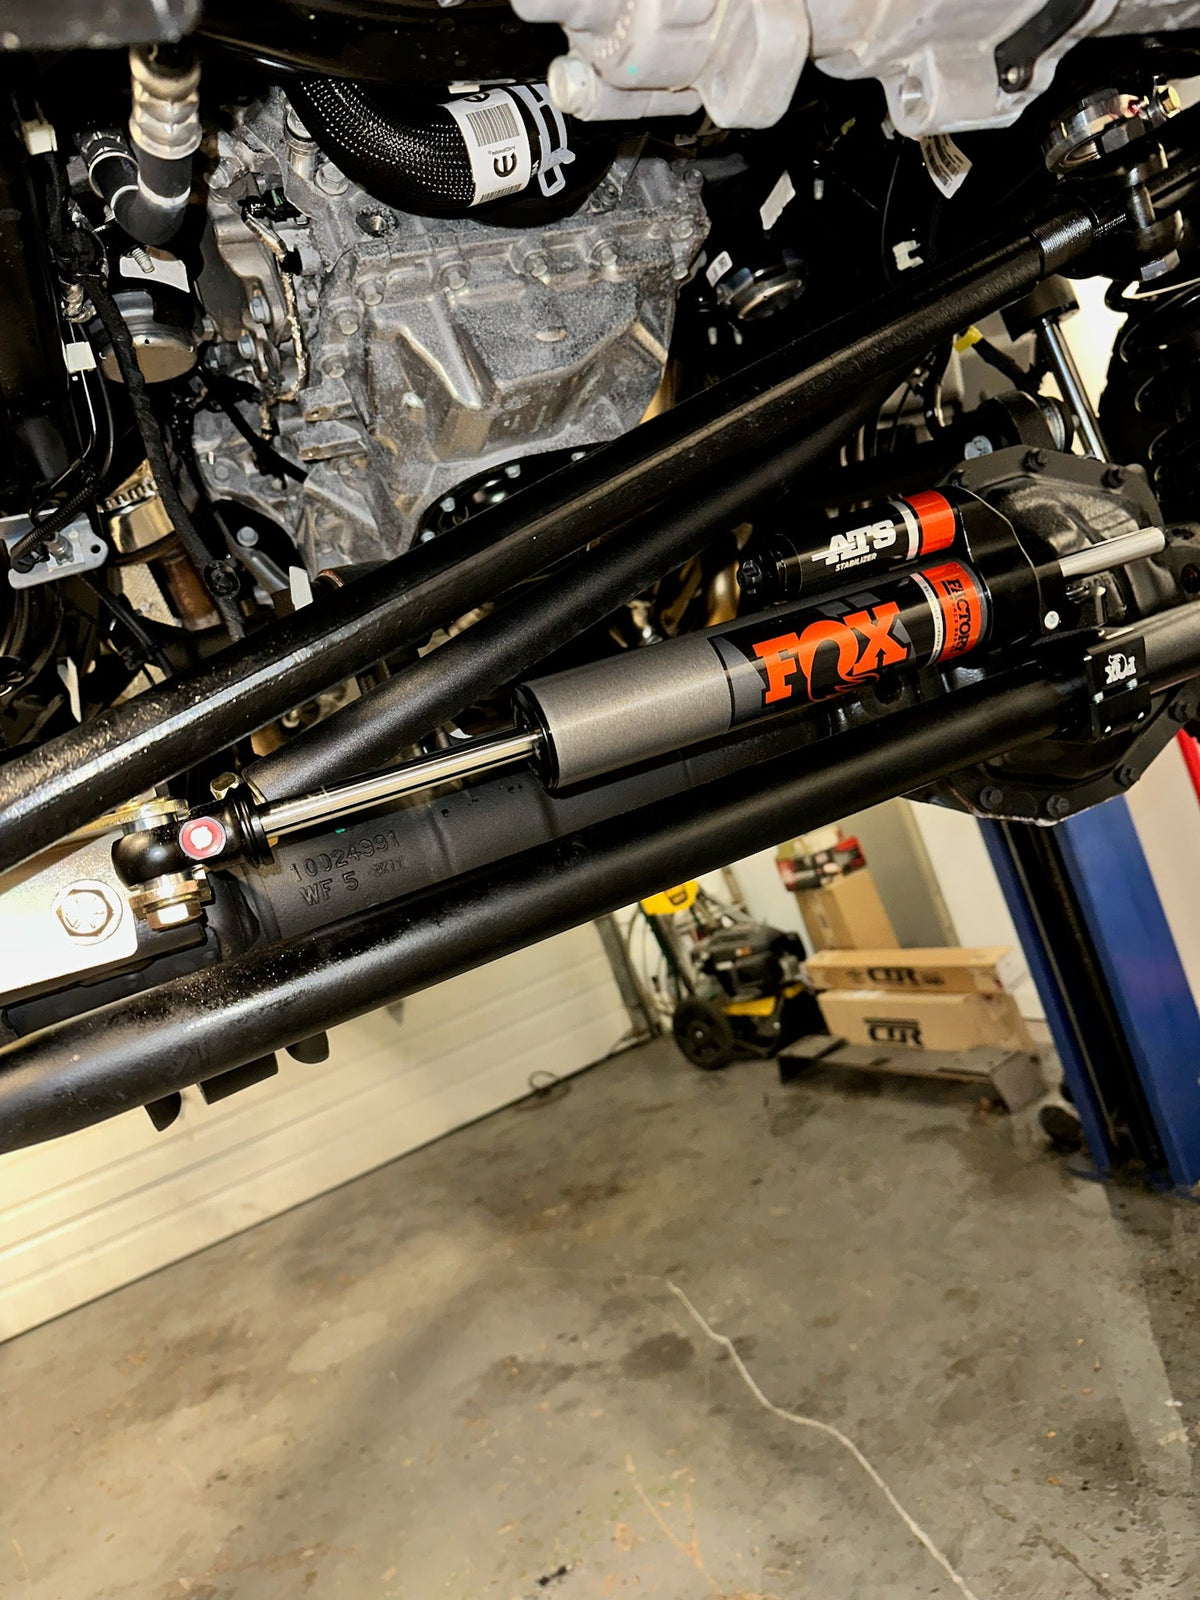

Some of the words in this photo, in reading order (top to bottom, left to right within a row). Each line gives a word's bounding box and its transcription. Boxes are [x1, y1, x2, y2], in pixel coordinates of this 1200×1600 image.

[811, 519, 897, 566] ATS
[835, 552, 878, 572] STABILIZER
[947, 578, 971, 653] FACTORY
[752, 600, 908, 705] FOX
[1104, 652, 1137, 685] FOX
[299, 878, 333, 906] WF
[342, 870, 359, 891] 5
